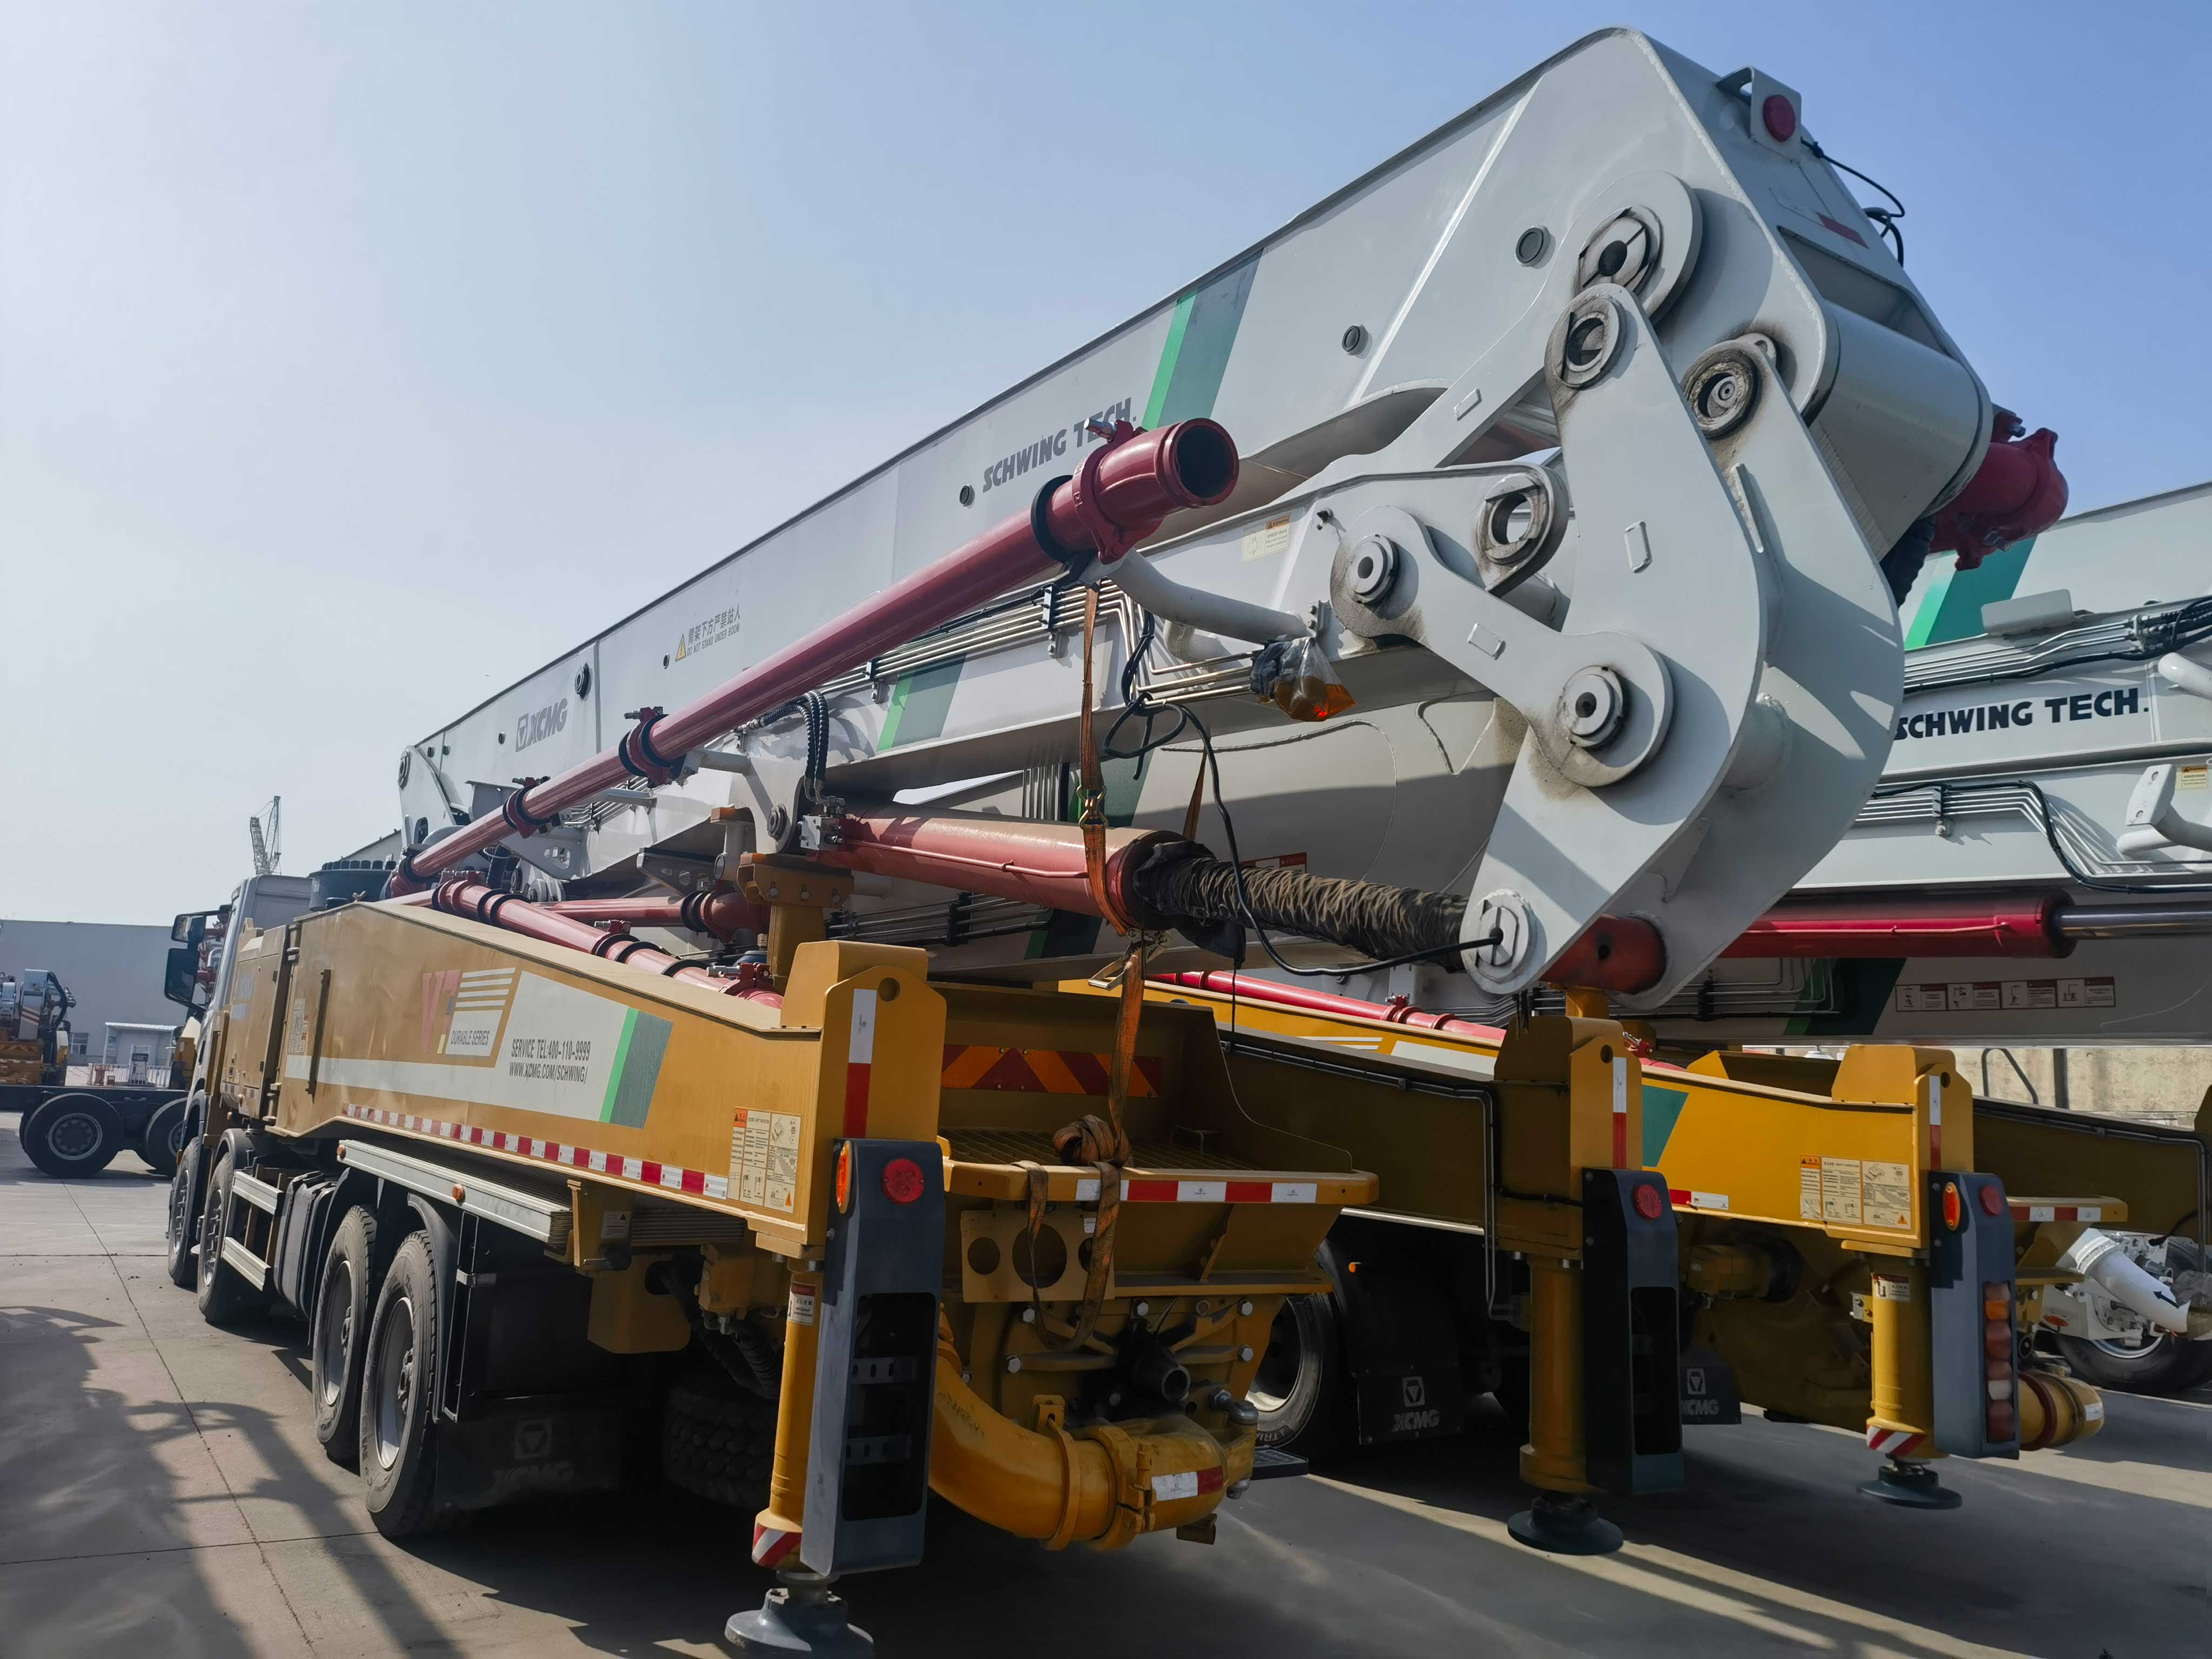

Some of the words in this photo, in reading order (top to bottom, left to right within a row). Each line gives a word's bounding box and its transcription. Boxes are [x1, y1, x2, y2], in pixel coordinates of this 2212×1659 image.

[982, 429, 1068, 493] SCHWING
[686, 646, 693, 657] DO
[693, 642, 702, 653] NOT
[702, 636, 714, 650] STAND
[714, 629, 727, 644] UNDER
[728, 623, 740, 637] BOOM
[688, 603, 740, 645] 臂架下方严禁站人
[527, 698, 568, 746] XCMG
[1894, 702, 2033, 740] SCHWING
[2045, 687, 2149, 723] TECH.
[451, 1030, 471, 1045] DURABLE
[471, 1030, 490, 1046] SERIES
[511, 1038, 535, 1058] SERVICE
[536, 1039, 591, 1061] TEL:400-110-9999
[509, 1062, 588, 1084] WWW.XCMG.COM/SCHWING/
[1391, 1409, 1439, 1433] XCMG
